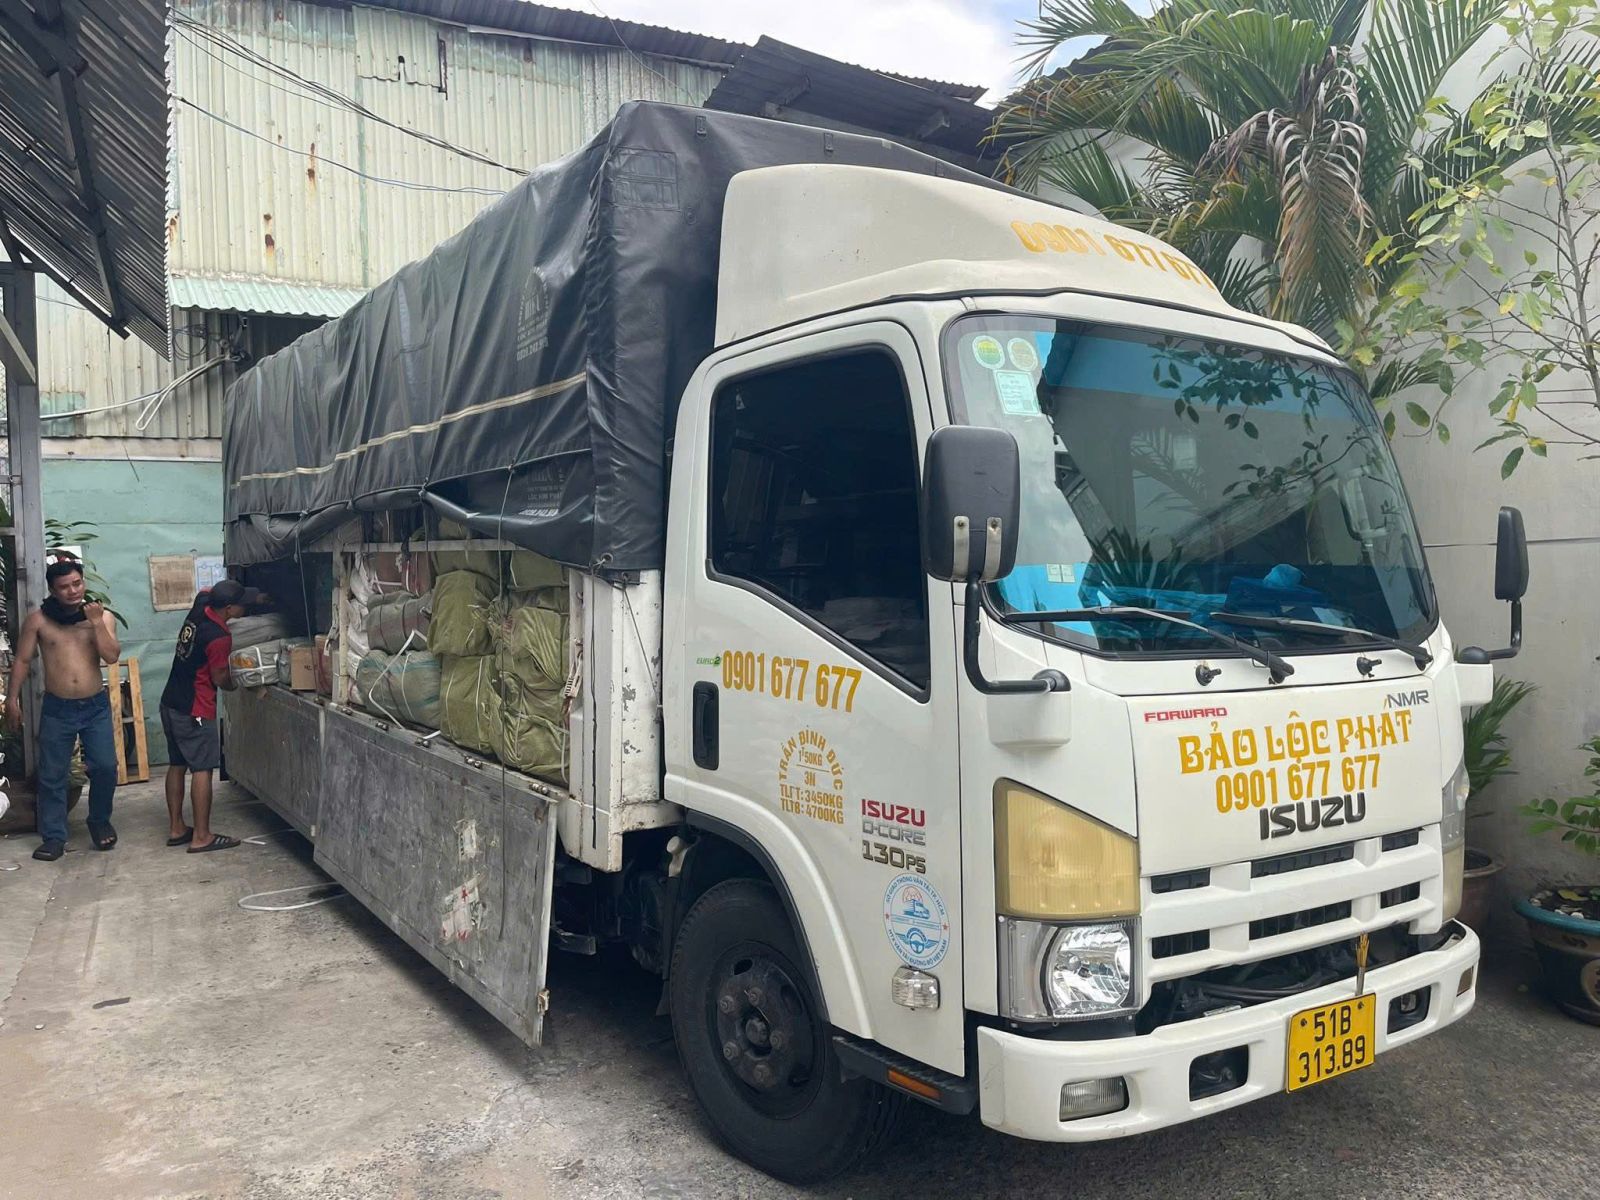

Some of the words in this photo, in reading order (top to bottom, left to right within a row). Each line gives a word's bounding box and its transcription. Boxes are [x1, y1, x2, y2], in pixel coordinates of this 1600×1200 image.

[1010, 221, 1107, 256] 0901
[1103, 234, 1168, 272] 677
[722, 650, 764, 692] 0901
[771, 656, 809, 701] 677
[815, 664, 862, 712] 677
[1144, 707, 1228, 722] FORWARD
[1387, 689, 1430, 708] NMR
[1177, 721, 1258, 774] BẢO
[1265, 711, 1330, 764] LỘC
[1215, 767, 1278, 814] 0901
[1288, 762, 1331, 801] 677
[1342, 753, 1380, 793] 677
[861, 799, 925, 827] ISUZU
[862, 820, 926, 846] D-CORE
[1259, 792, 1366, 840] ISUZU
[1314, 1005, 1351, 1042] 51B
[1299, 1035, 1365, 1083] 313.89
